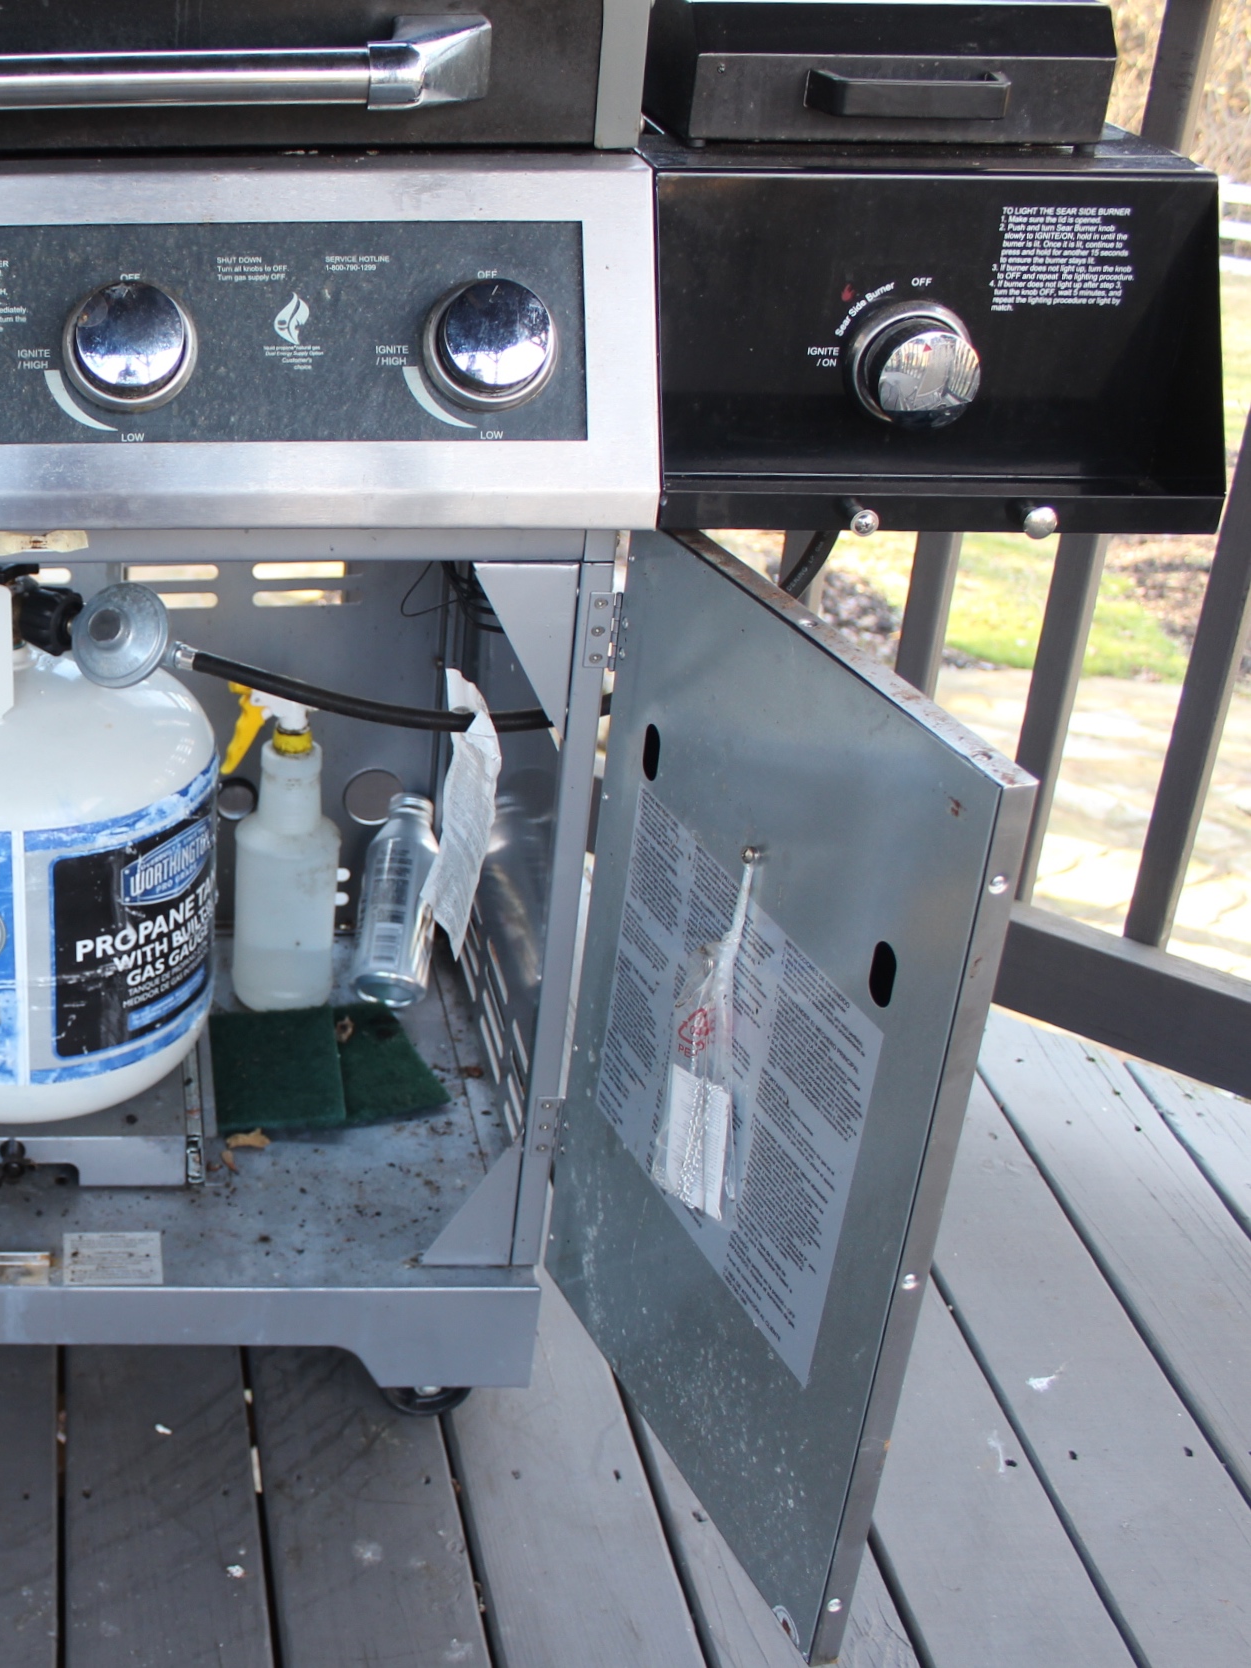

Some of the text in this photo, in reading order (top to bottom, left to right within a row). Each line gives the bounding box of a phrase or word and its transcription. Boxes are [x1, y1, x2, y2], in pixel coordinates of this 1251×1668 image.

[1003, 207, 1013, 215] TO
[1015, 207, 1036, 215] LIGHT
[1040, 207, 1054, 215] THE
[1056, 207, 1076, 215] SEAR
[1074, 224, 1096, 232] Burner
[477, 270, 497, 279] OFF
[911, 278, 932, 286] OFF
[835, 282, 895, 336] Sear Side Burner
[17, 350, 51, 358] IGNITE
[375, 345, 409, 354] IGNITE
[808, 347, 840, 356] IGNITE
[121, 433, 144, 442] LOW
[480, 430, 503, 440] LOW
[156, 880, 173, 893] PRO
[75, 895, 195, 963] PROPANE
[113, 942, 168, 972] WITH
[126, 930, 208, 986] GAS GAUGE
[128, 977, 160, 996] TANQUE
[122, 989, 159, 1008] MEDIDOR
